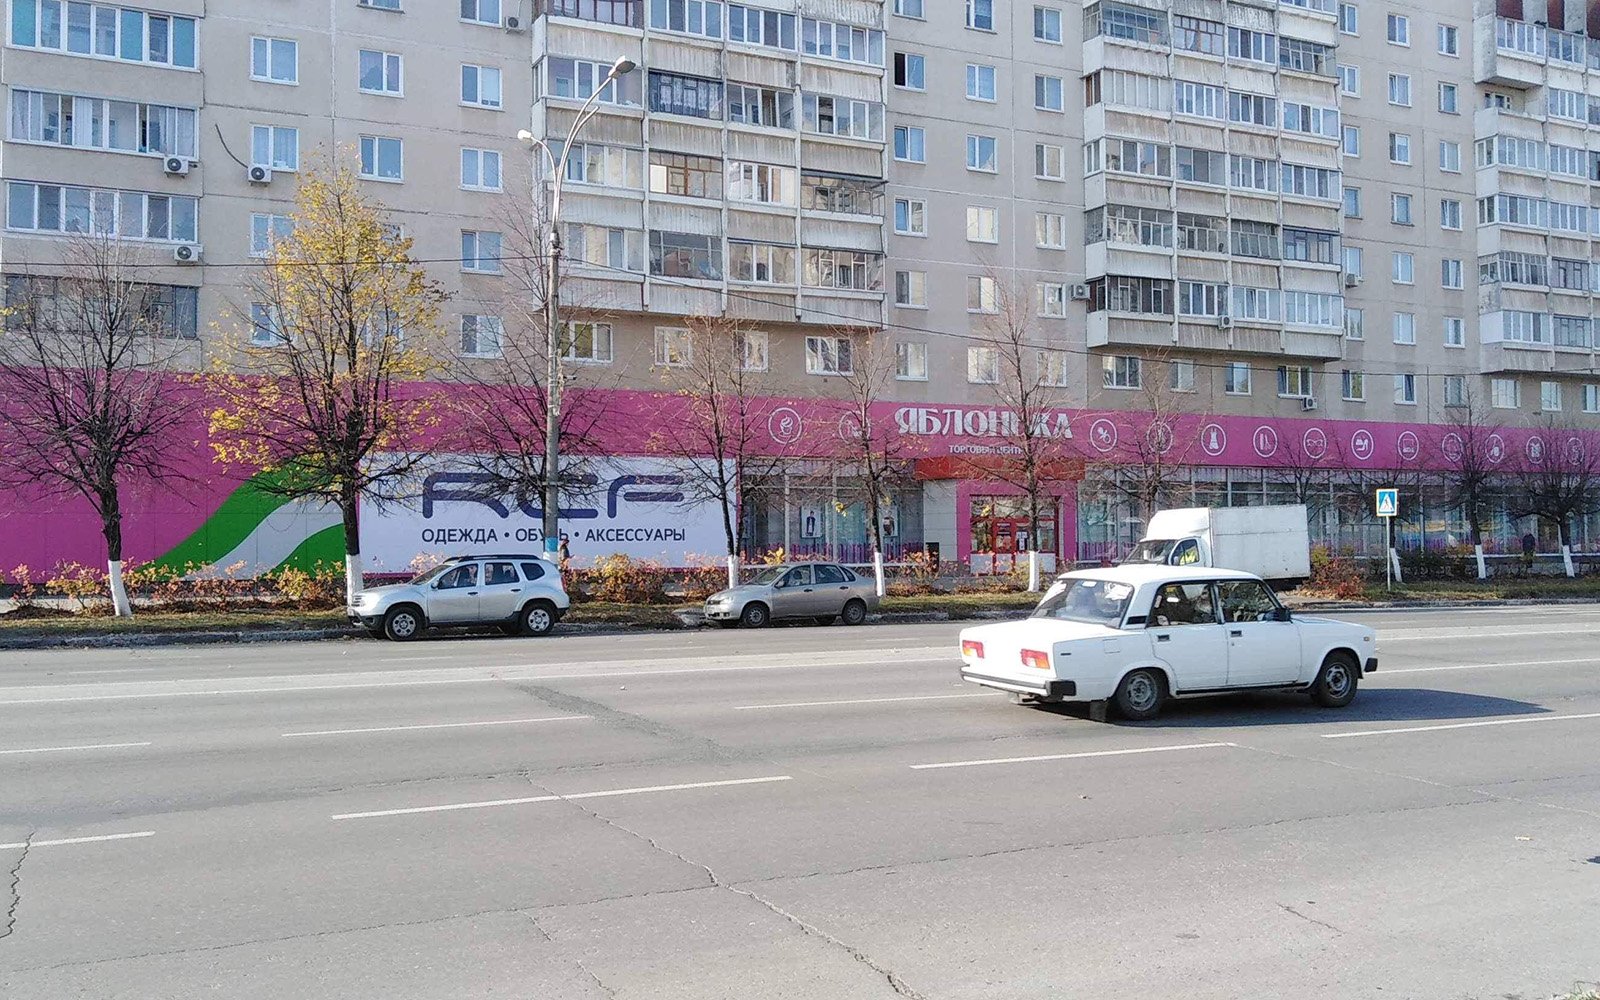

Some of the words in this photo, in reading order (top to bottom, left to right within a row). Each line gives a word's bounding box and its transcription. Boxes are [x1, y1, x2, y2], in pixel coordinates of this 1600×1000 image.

[421, 528, 498, 544] ОДЕЖДА
[515, 528, 569, 542] ОБУЬ
[585, 528, 686, 542] АКСЕССУАРЫ
